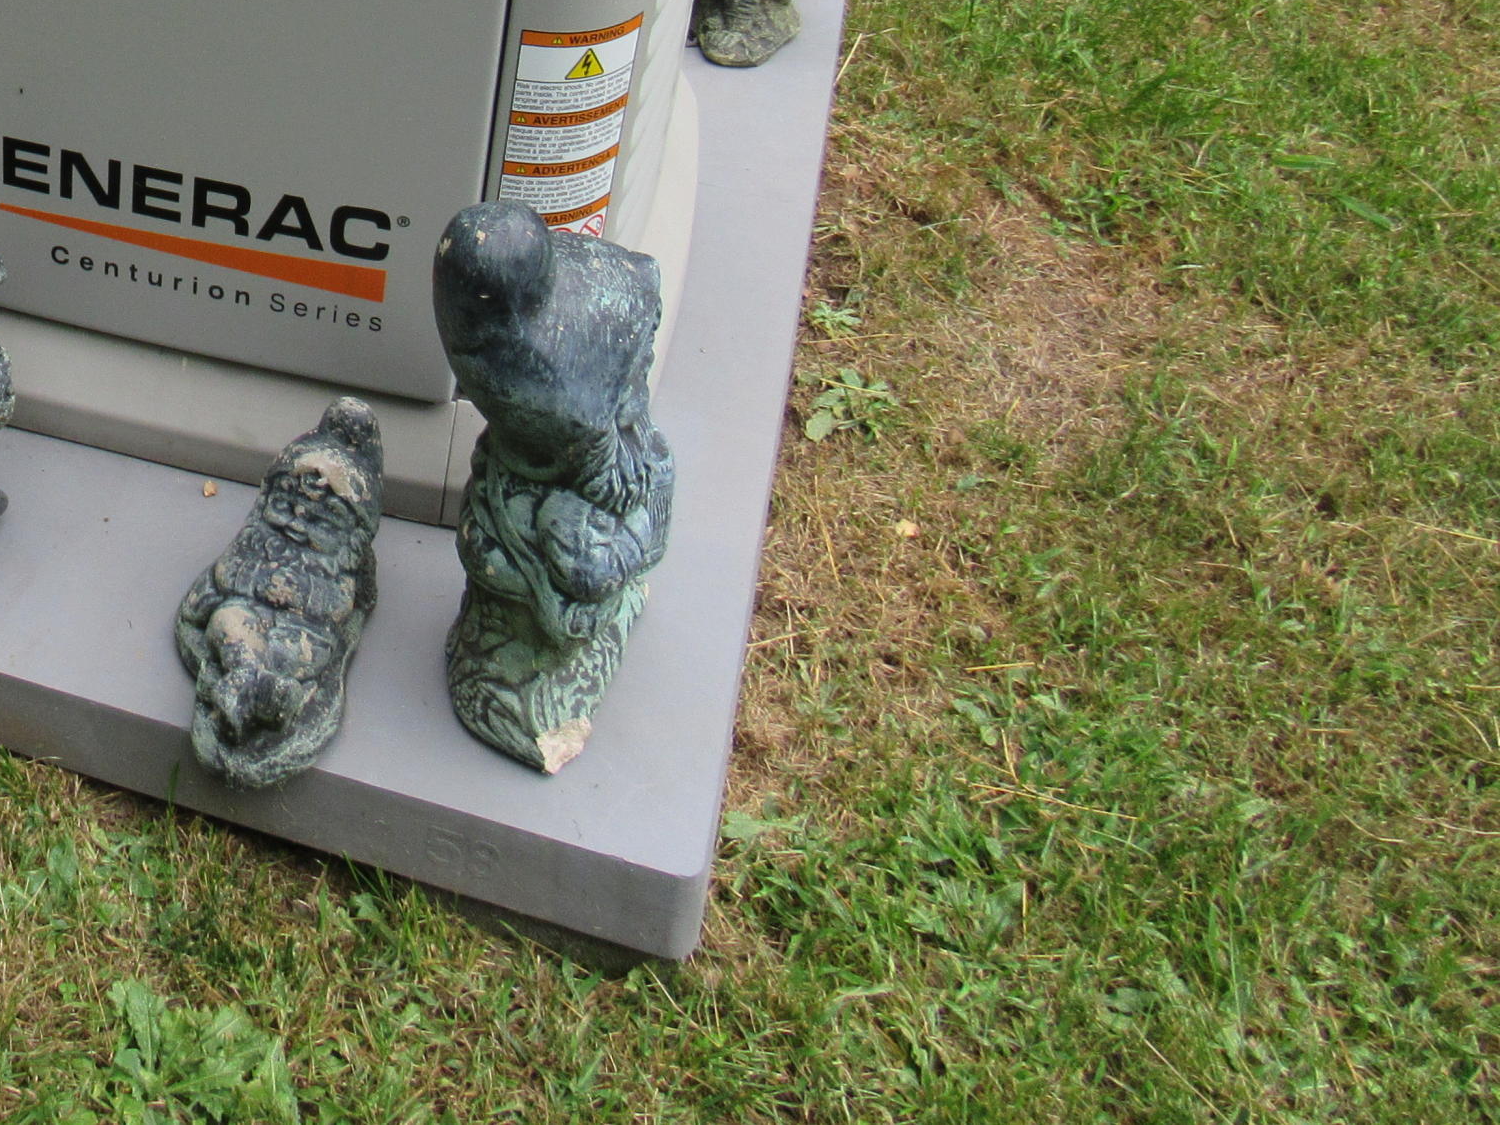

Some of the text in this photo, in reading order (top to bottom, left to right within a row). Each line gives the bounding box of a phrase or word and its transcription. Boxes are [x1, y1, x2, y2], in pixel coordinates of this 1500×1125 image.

[569, 26, 625, 45] WARNING
[533, 98, 626, 125] AVERTISSEMENT
[532, 152, 611, 176] ADVERTENCIA
[50, 245, 383, 333] Centurion Series
